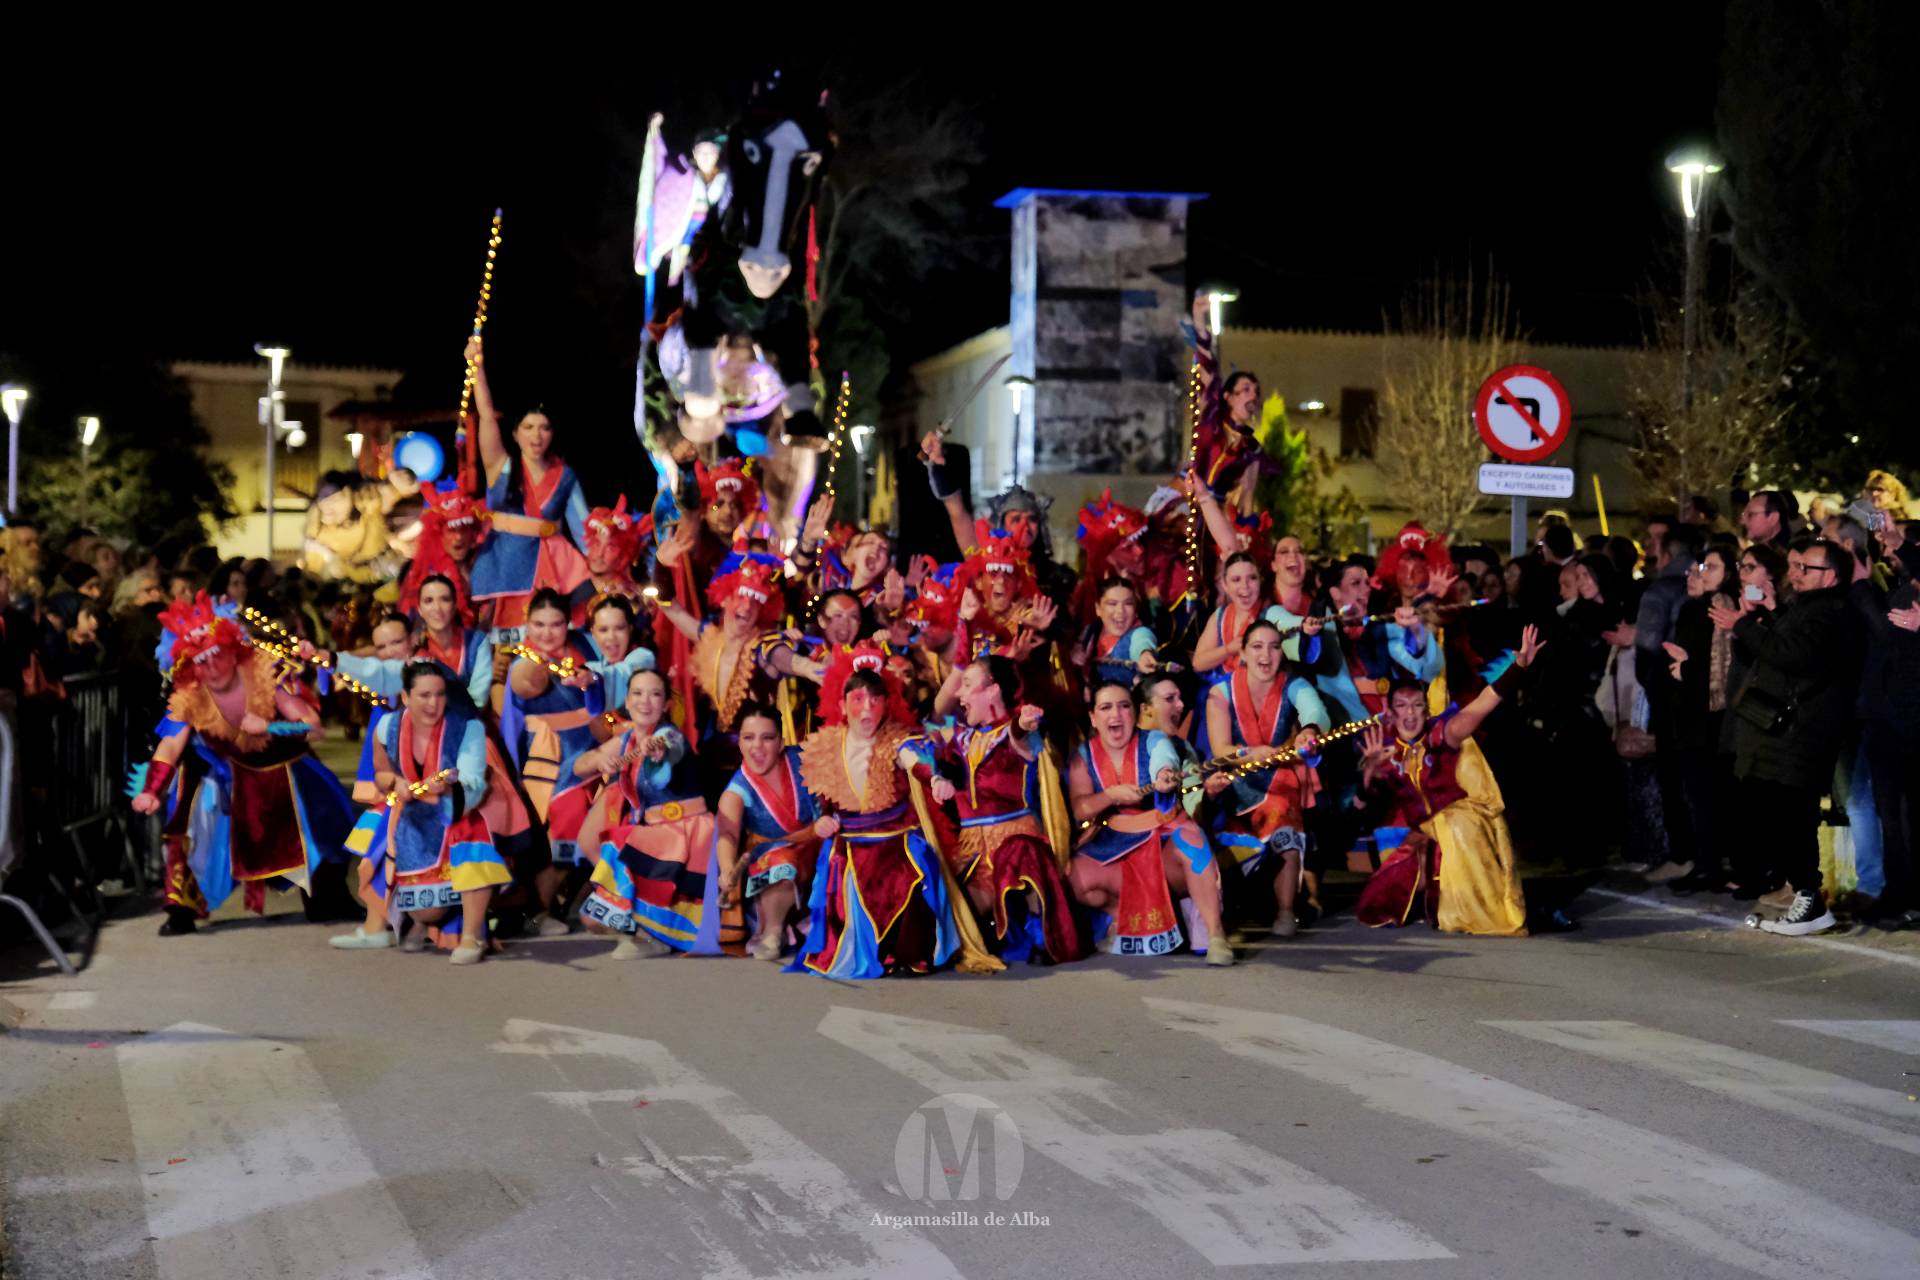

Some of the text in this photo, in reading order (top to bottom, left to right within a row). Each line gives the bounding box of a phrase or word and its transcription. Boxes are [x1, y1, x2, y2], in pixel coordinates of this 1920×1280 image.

[1481, 470, 1571, 481] EXCEPTO CAMIONES
[1504, 482, 1557, 491] AUTOBUSES
